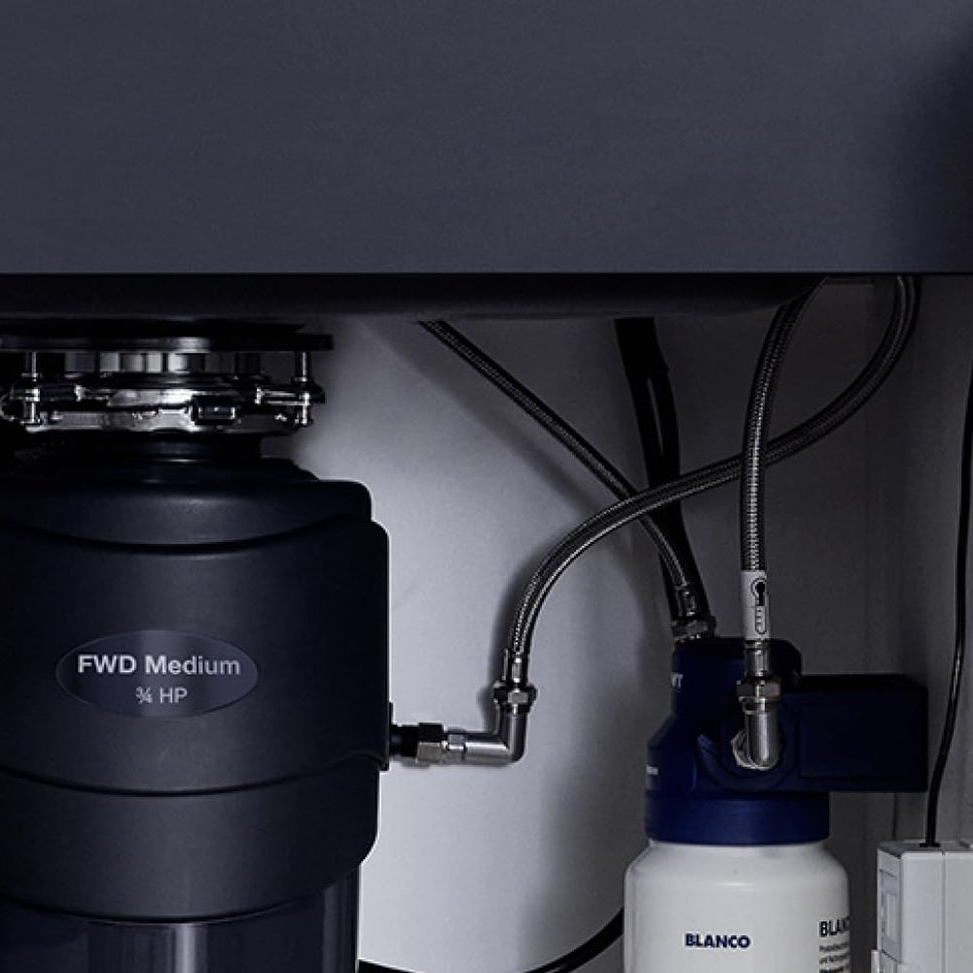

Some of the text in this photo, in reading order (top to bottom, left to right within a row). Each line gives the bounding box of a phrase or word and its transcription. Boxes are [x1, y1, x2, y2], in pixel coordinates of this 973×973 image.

[77, 654, 241, 675] FWD Medium
[159, 687, 188, 704] HP
[685, 933, 751, 948] BLANCO
